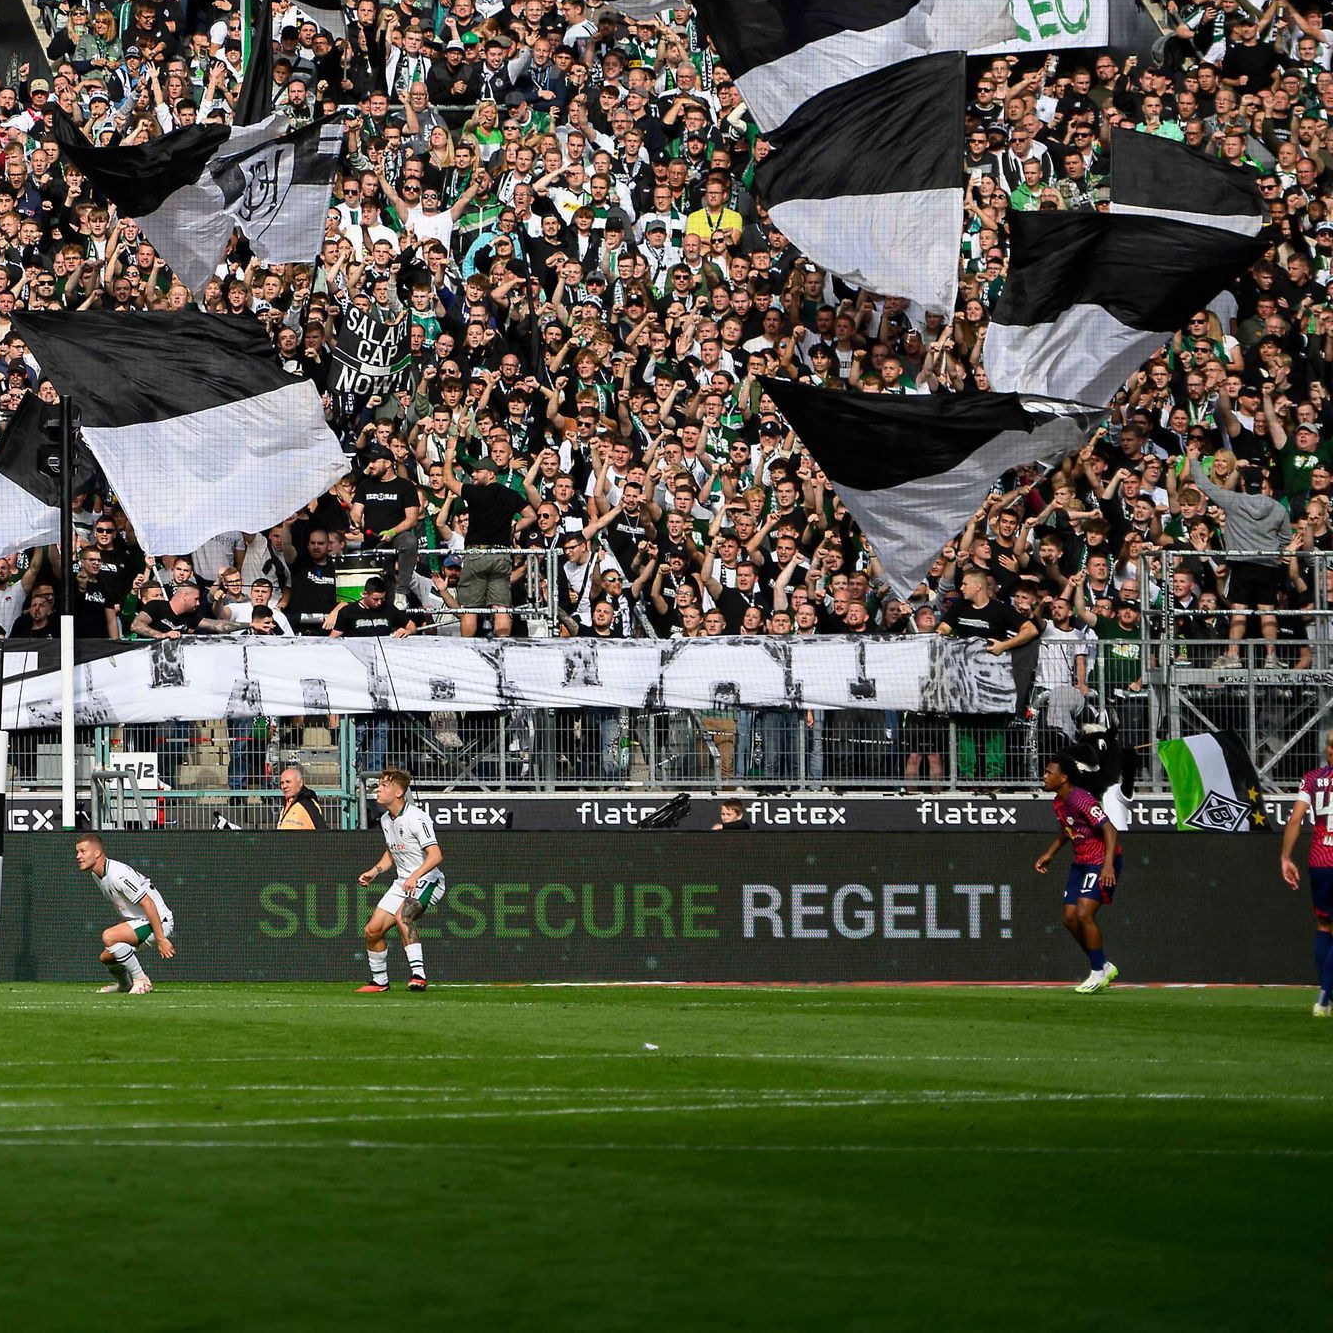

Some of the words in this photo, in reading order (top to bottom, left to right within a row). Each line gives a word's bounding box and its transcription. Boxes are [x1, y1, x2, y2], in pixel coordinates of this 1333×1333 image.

[357, 340, 398, 367] CAP
[421, 801, 507, 826] latex
[576, 802, 655, 825] flat
[746, 802, 847, 825] flatex
[917, 802, 1017, 825] flatex
[1082, 873, 1098, 889] 17
[258, 882, 720, 940] SUSECURE
[741, 882, 1013, 940] REGELT!
